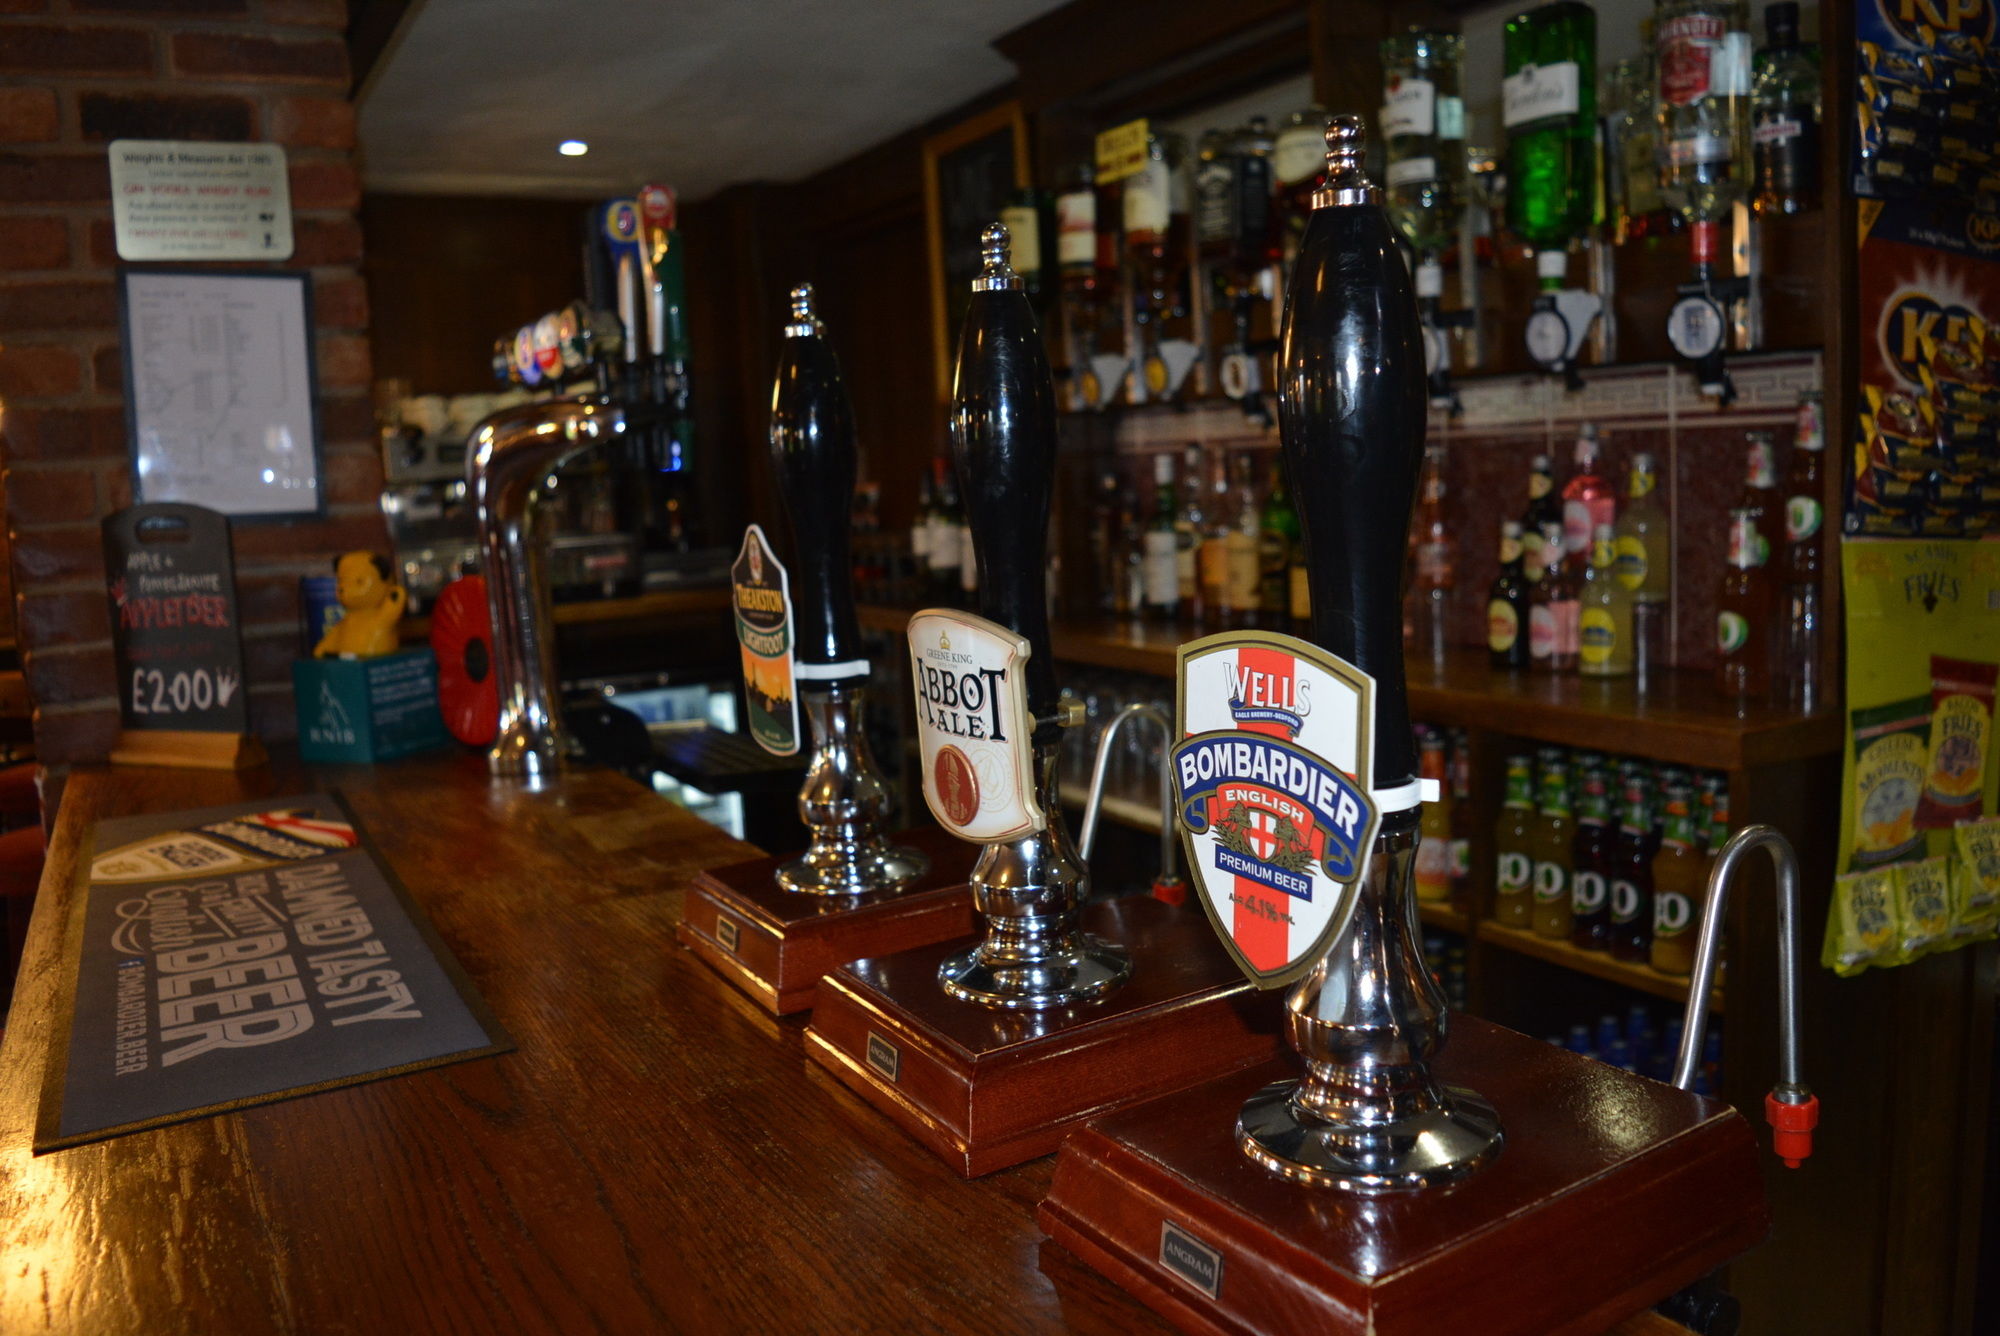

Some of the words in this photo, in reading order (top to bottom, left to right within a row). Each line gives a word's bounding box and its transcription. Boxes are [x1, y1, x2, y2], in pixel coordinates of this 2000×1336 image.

[735, 583, 785, 613] THEAKSTON
[926, 648, 950, 662] GREENE
[951, 653, 973, 664] KING
[1223, 661, 1311, 717] WELLS
[917, 657, 1006, 741] ABBOT
[937, 709, 985, 738] ALE
[1180, 742, 1359, 840] BOMBARDIER
[1225, 789, 1305, 823] ENGLISH
[275, 862, 374, 946] DAMNED
[1219, 852, 1272, 882] PREMIUM
[1274, 873, 1308, 895] BEER
[156, 932, 315, 1067] BEER
[306, 939, 423, 1027] TASTY
[116, 965, 148, 1076] BOMBARDIER.BEER
